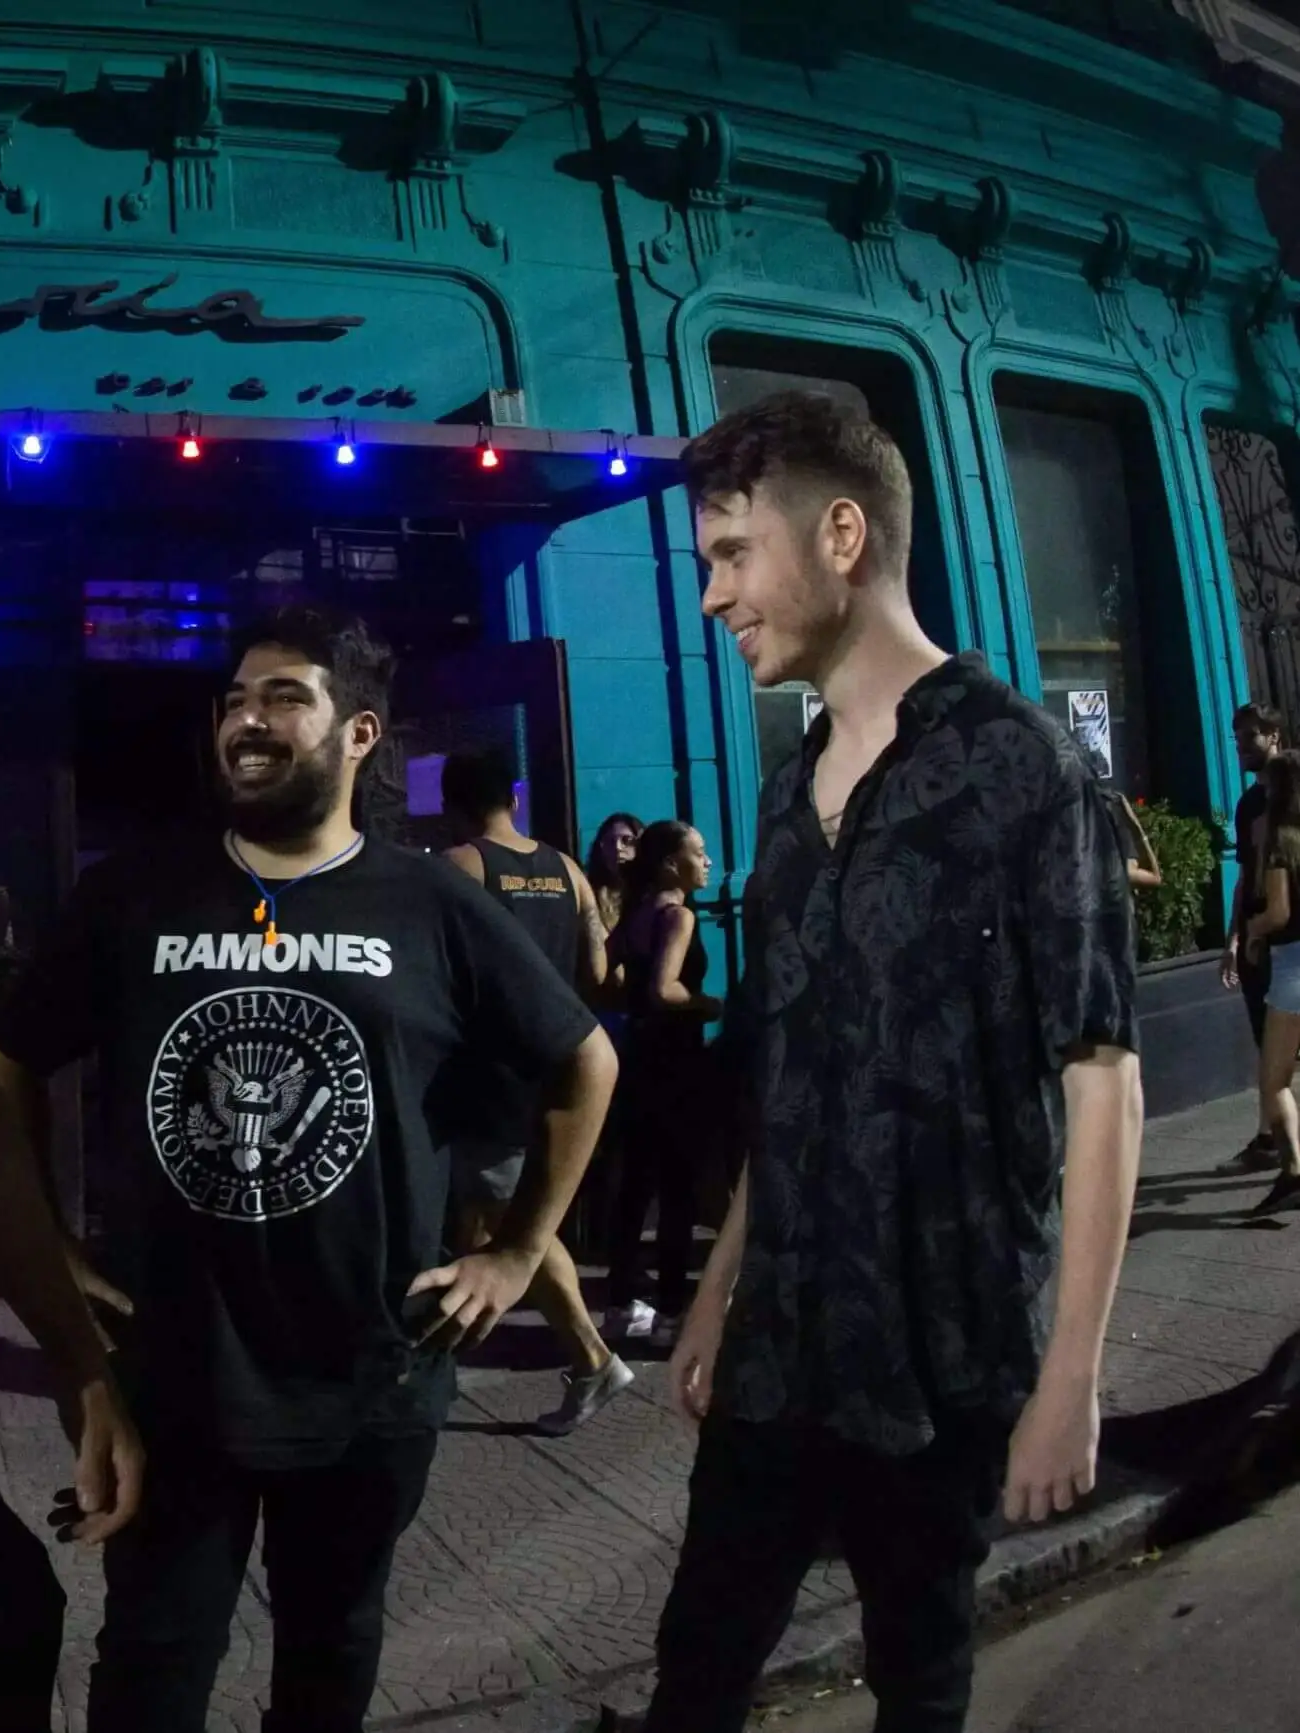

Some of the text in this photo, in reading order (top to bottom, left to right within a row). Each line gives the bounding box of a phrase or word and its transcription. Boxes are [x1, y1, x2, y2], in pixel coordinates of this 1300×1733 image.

[153, 933, 393, 977] RAMONES
[191, 993, 346, 1042] JOHNNY
[154, 1039, 190, 1180] TOMMY
[336, 1051, 368, 1149] JOEY
